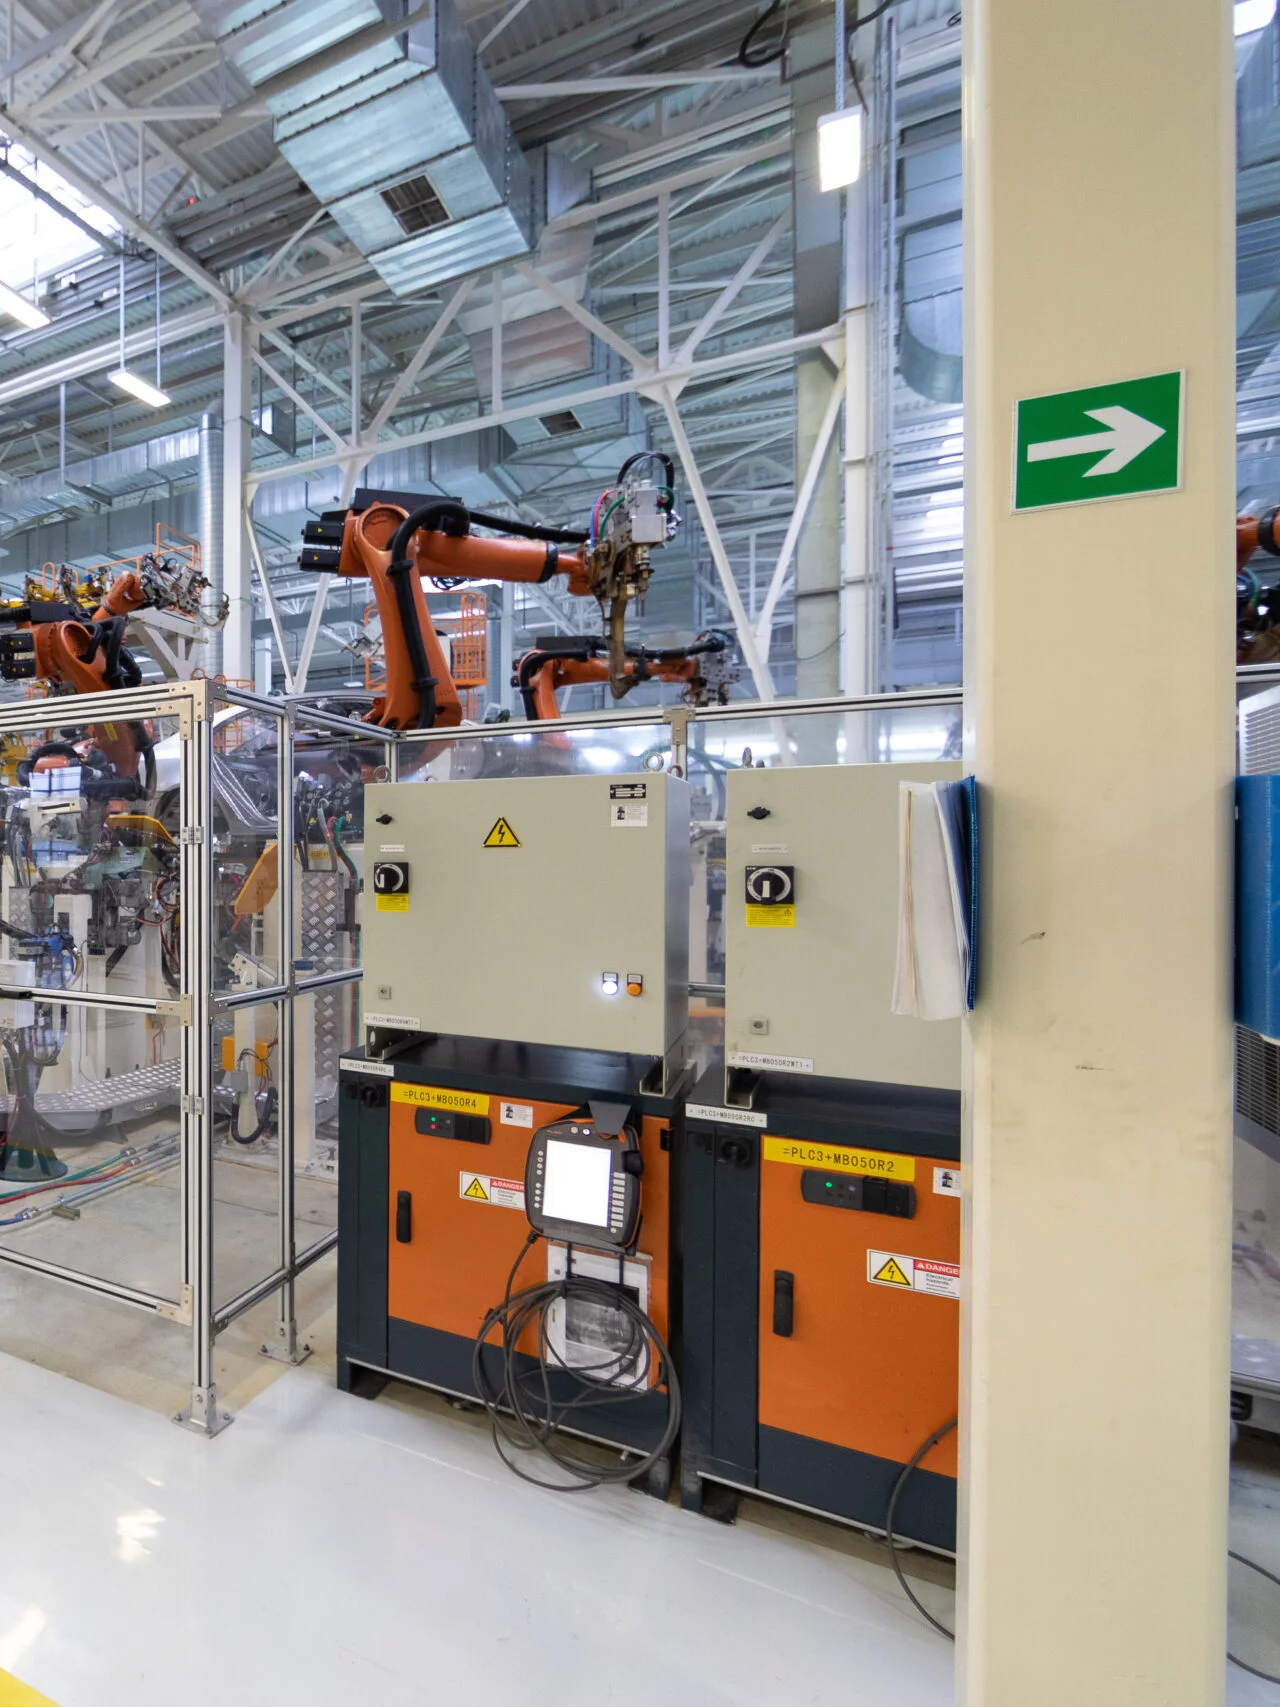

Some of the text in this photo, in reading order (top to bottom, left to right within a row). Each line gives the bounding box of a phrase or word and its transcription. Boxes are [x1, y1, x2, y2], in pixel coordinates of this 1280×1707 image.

[403, 1090, 477, 1108] =PLC3+MB050R4
[783, 1146, 895, 1173] =PLC3+MB050R2
[925, 1263, 960, 1275] DANGE
